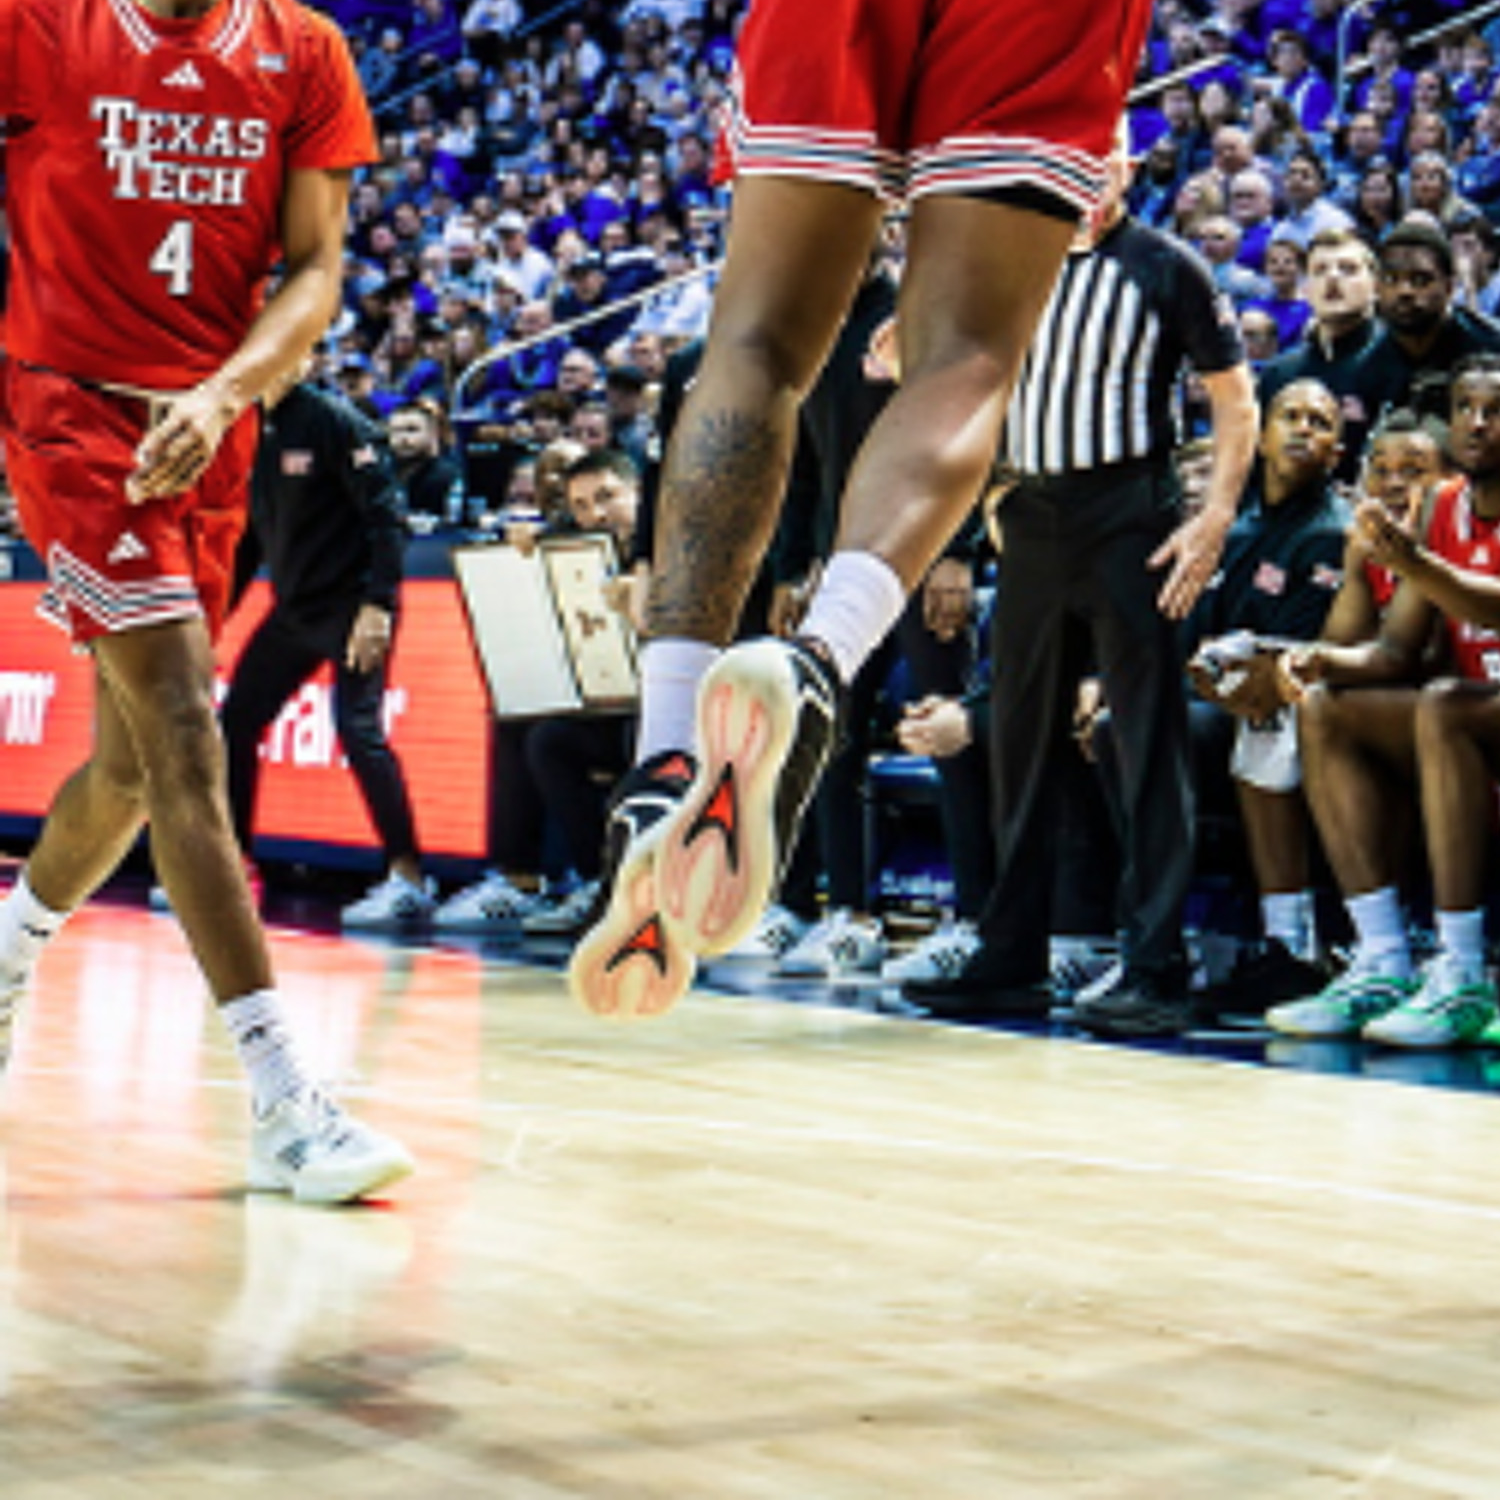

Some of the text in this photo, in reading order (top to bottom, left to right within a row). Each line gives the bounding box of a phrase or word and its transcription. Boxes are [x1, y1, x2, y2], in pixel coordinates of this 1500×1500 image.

[90, 96, 268, 160] TEXAS
[106, 148, 250, 206] TECH
[149, 220, 193, 296] 4
